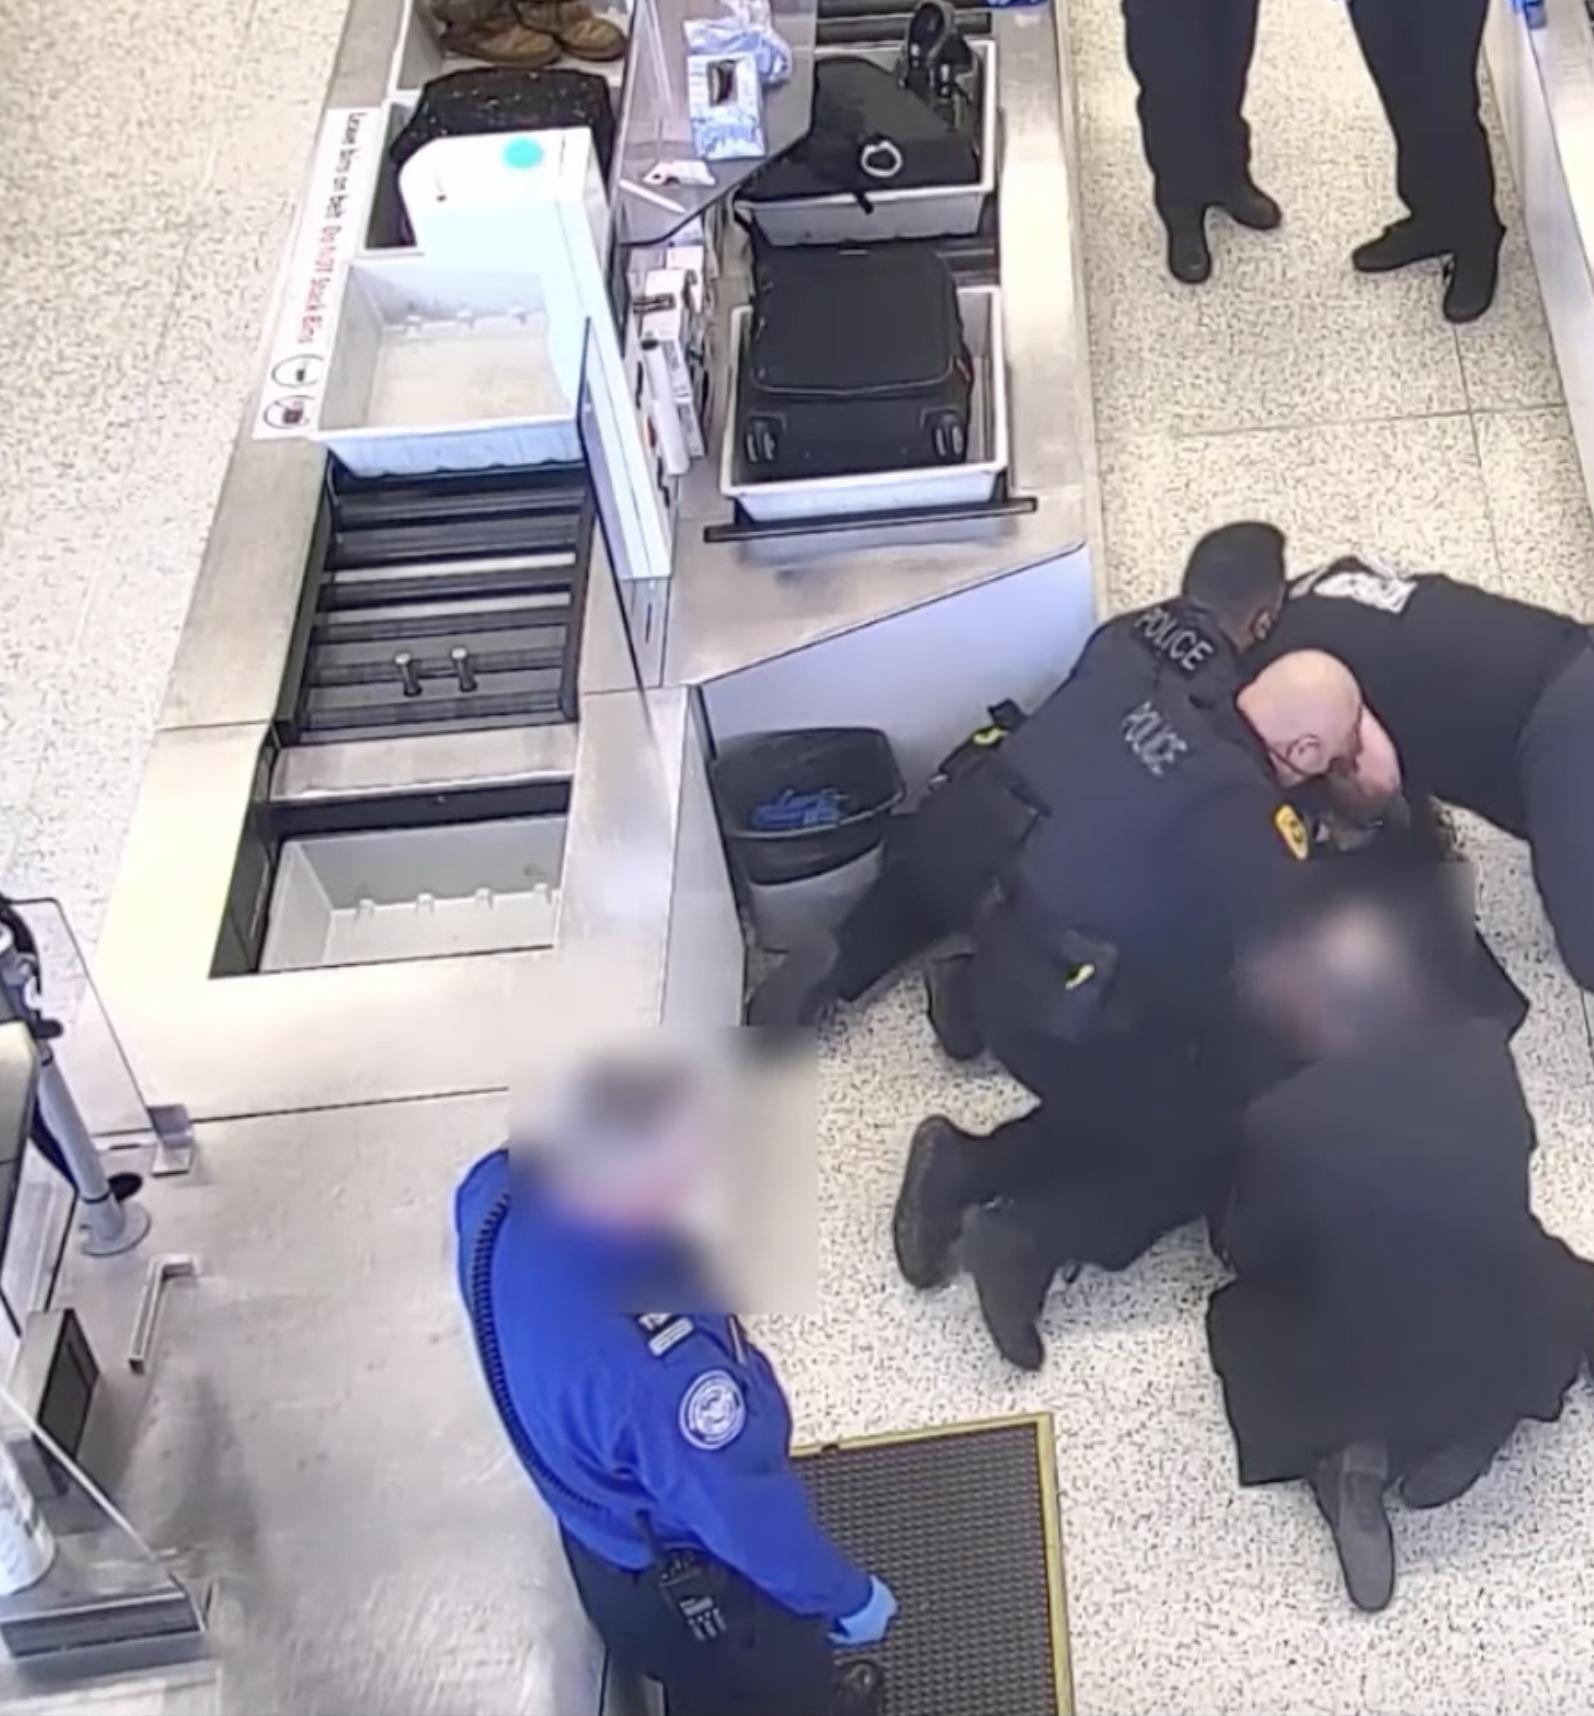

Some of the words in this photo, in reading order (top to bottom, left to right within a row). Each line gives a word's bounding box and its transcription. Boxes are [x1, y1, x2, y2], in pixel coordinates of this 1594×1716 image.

[342, 111, 368, 145] Leave
[306, 276, 331, 311] Stack
[1134, 606, 1214, 671] POLICE
[1121, 700, 1188, 776] POLICE
